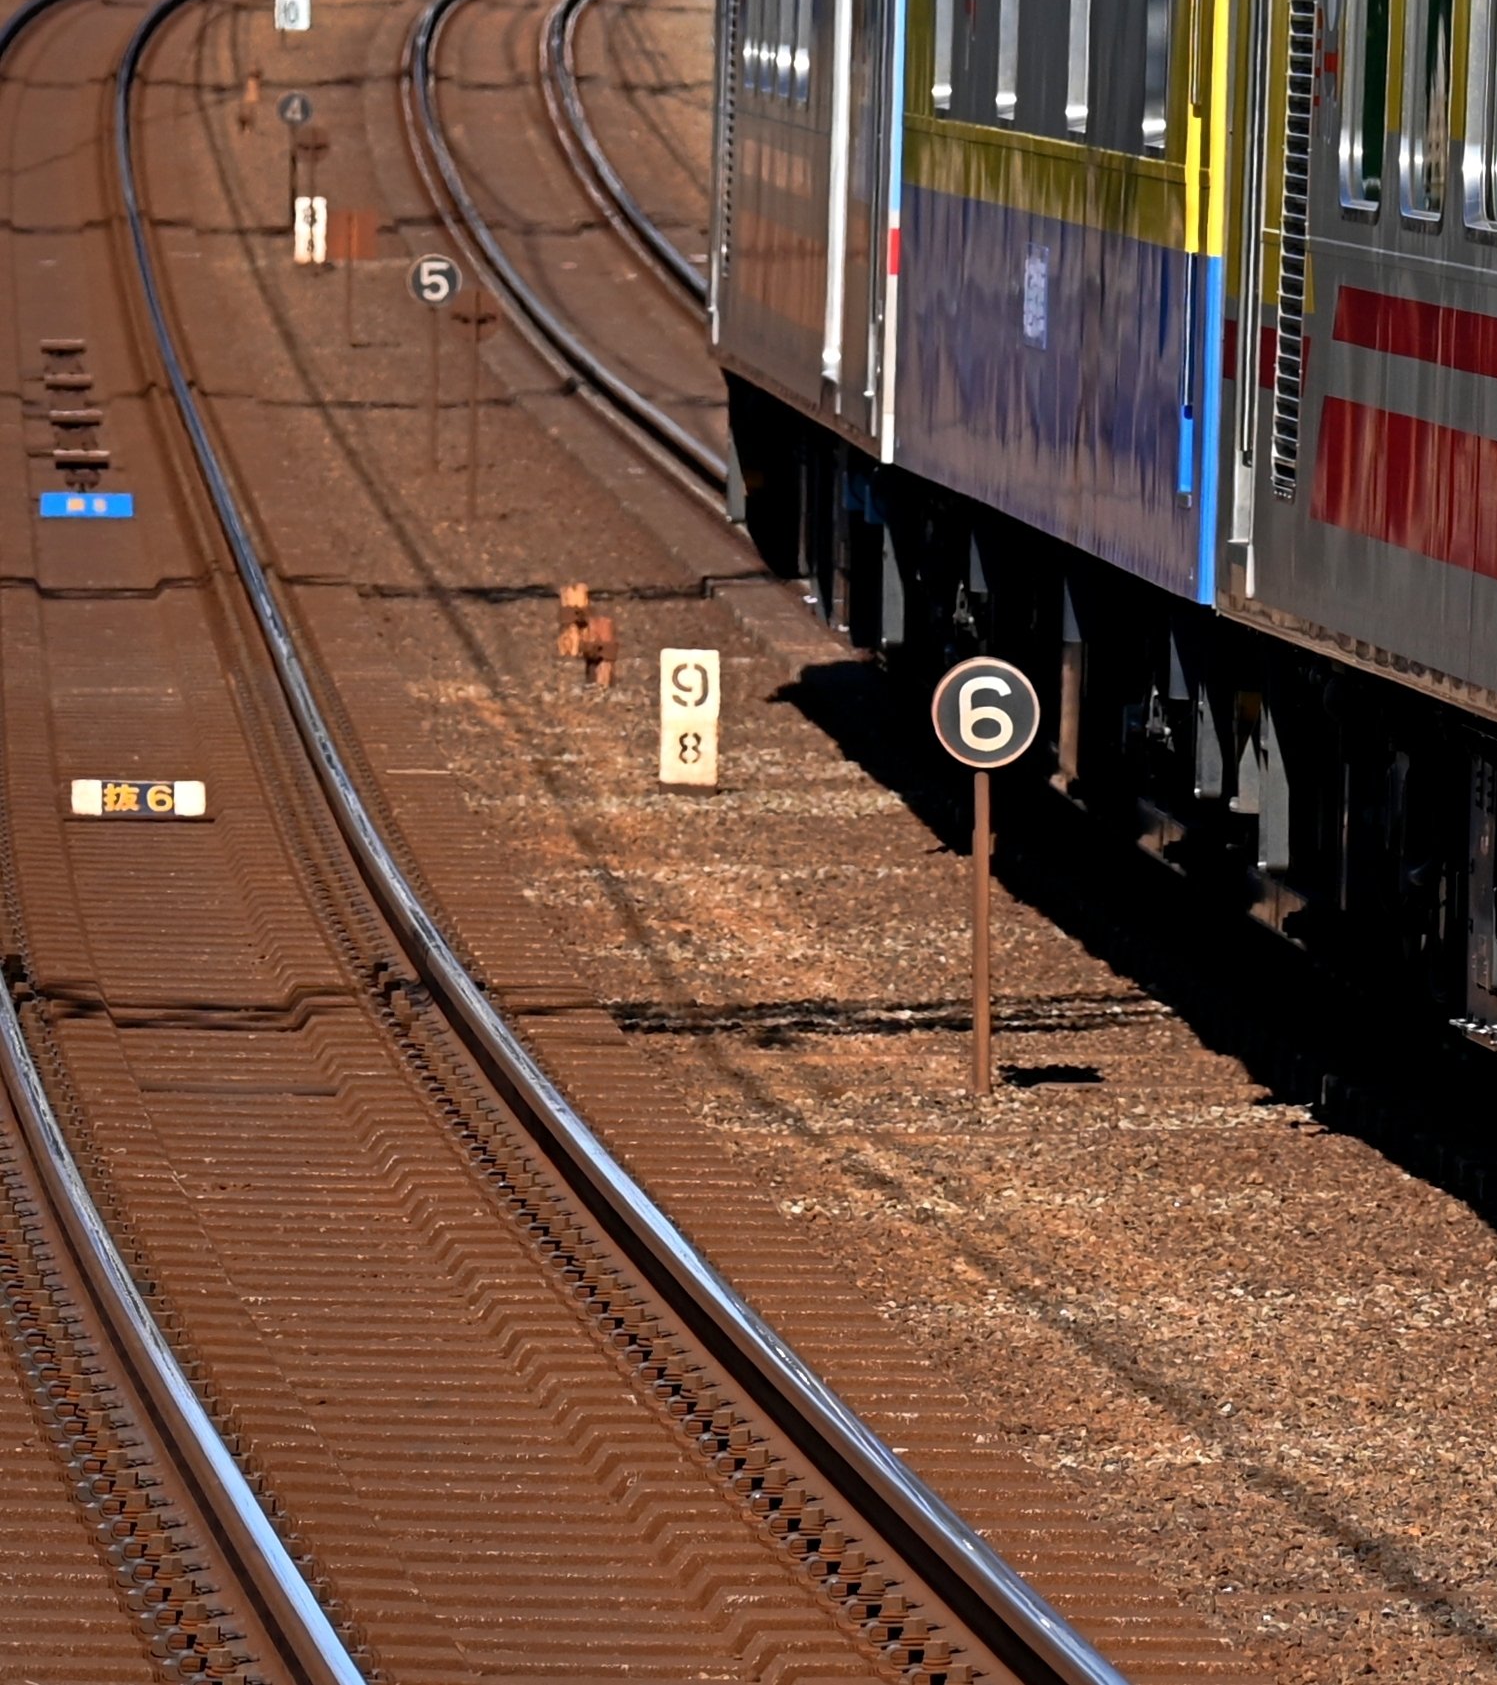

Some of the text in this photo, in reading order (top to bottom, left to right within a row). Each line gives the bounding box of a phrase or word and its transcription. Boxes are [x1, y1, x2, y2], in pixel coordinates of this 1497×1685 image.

[420, 261, 450, 301] 5
[672, 663, 709, 707] 9
[959, 676, 1013, 752] 6
[679, 732, 702, 764] 8
